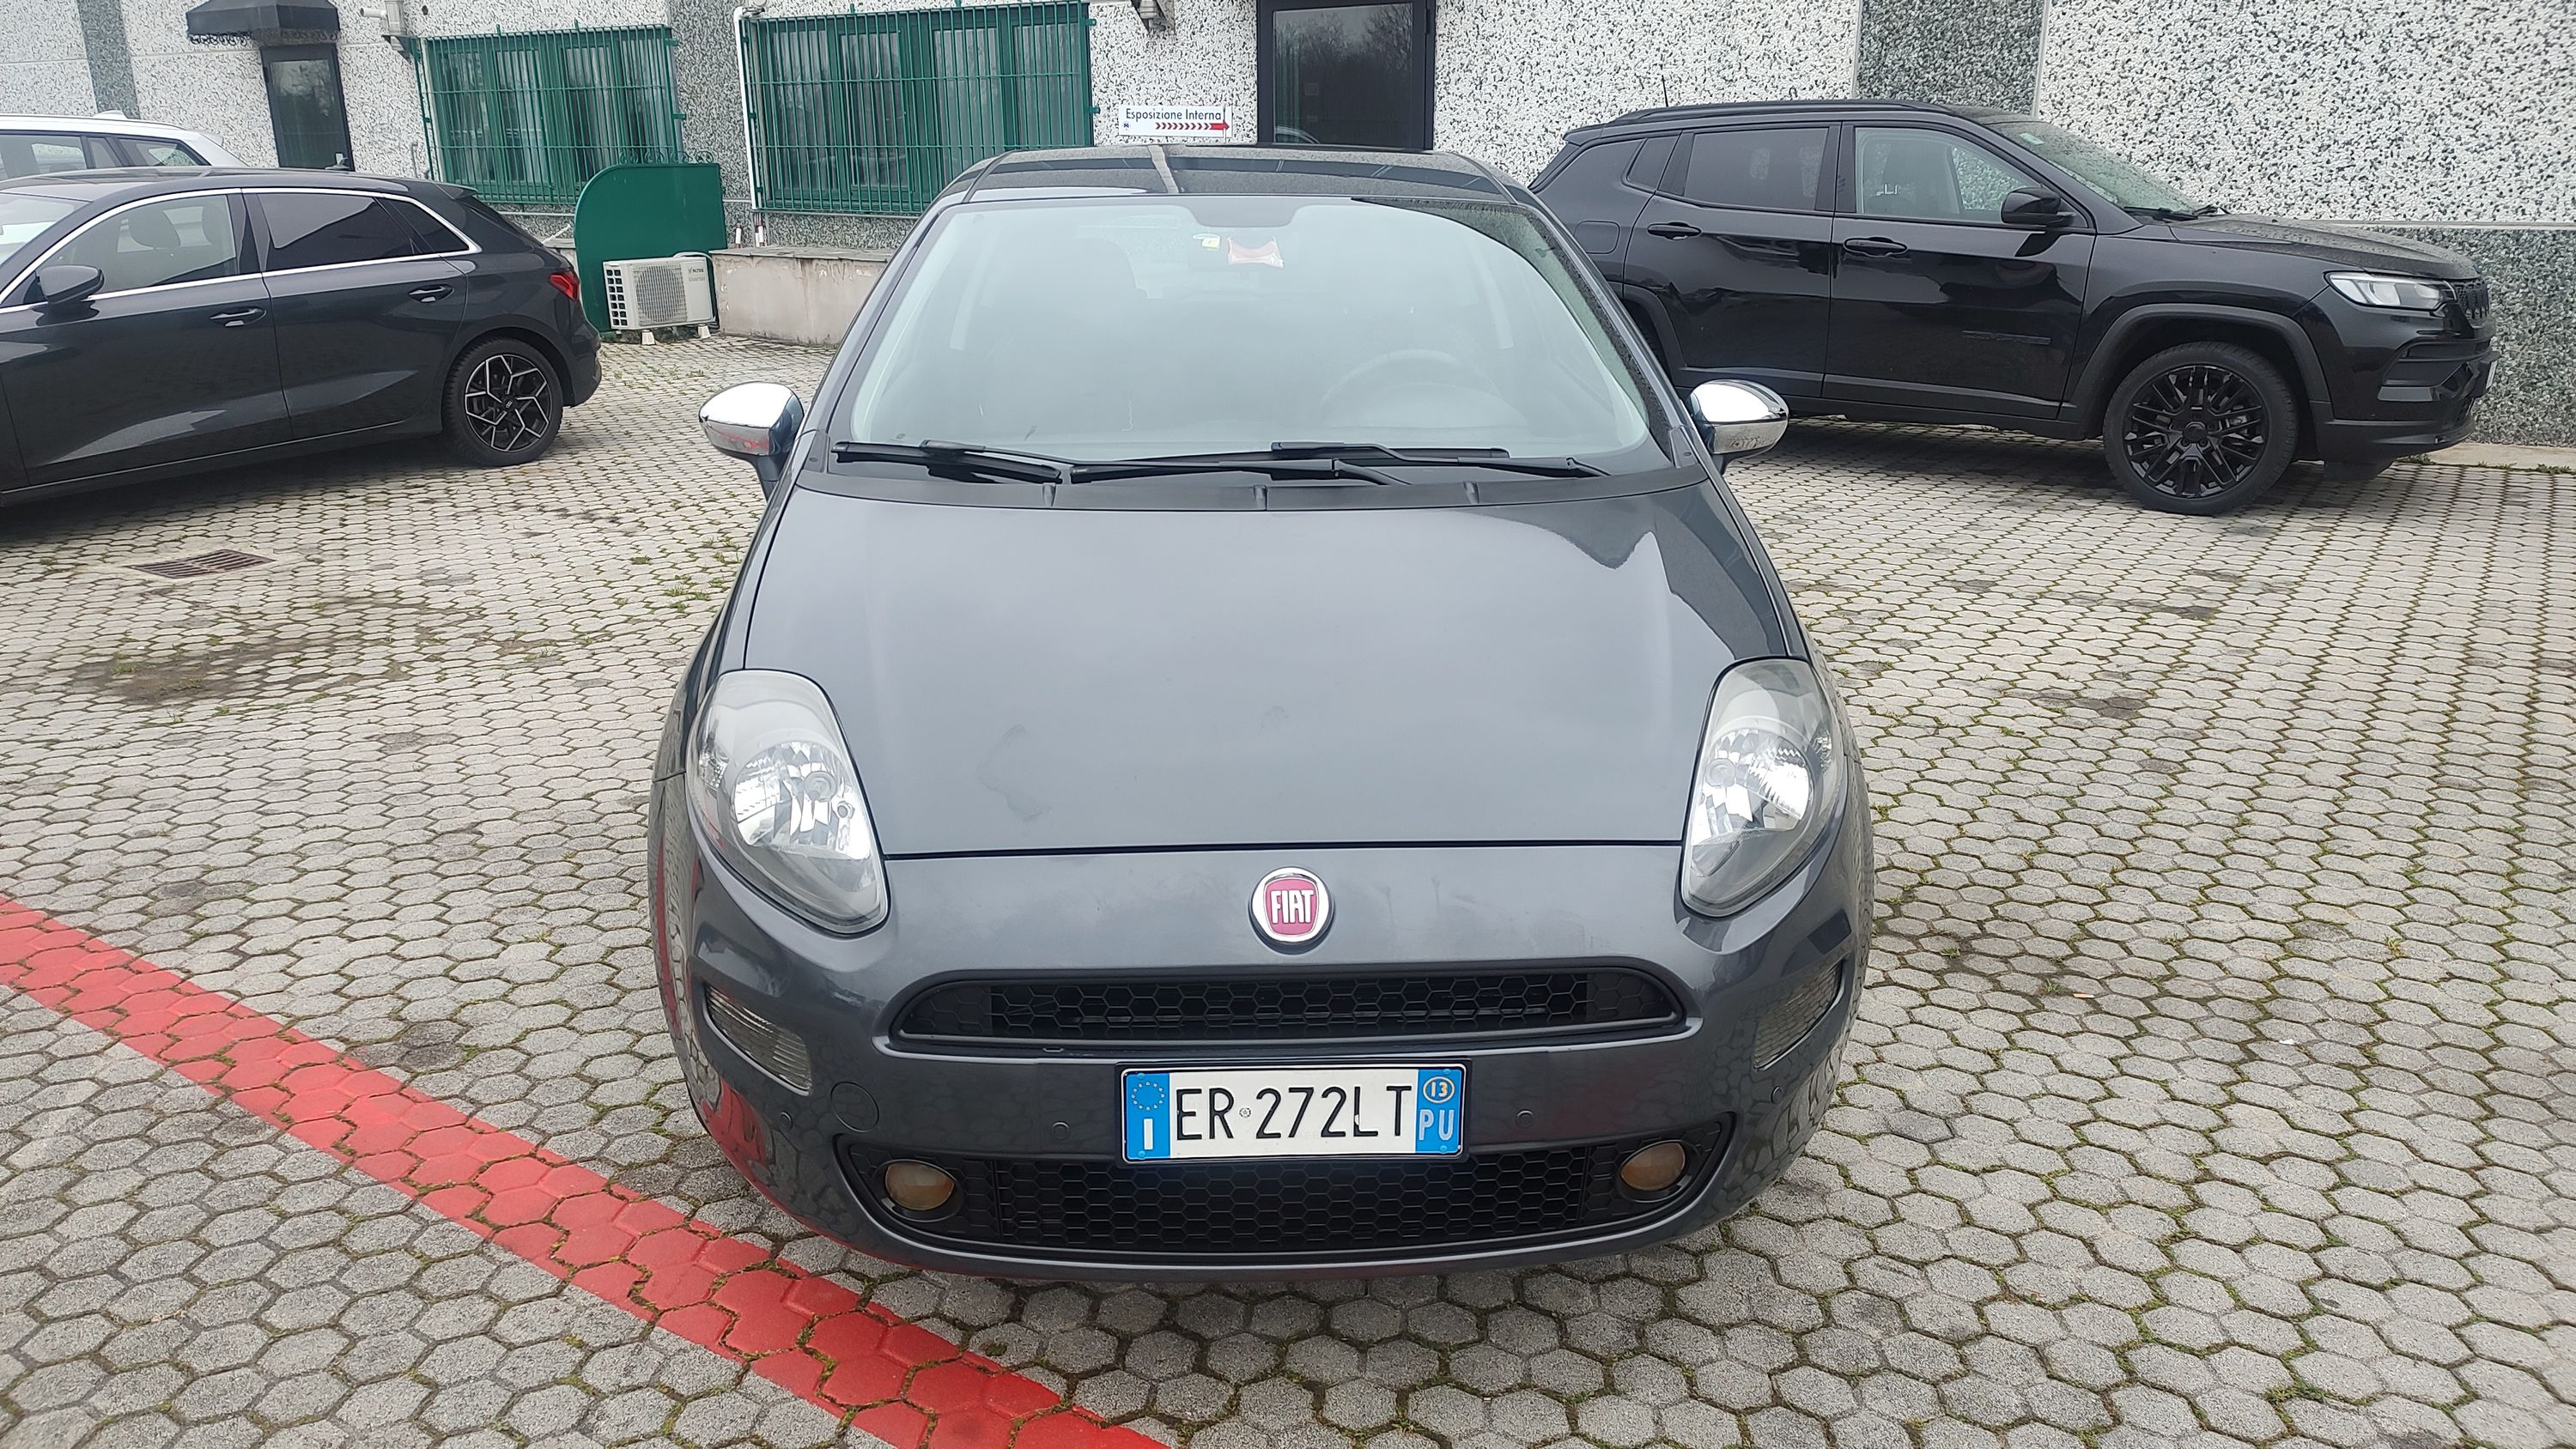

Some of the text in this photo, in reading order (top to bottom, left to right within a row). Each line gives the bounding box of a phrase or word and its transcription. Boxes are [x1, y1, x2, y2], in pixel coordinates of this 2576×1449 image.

[1125, 107, 1222, 122] Esposizione Interna
[1270, 889, 1315, 925] FIAT
[1430, 1081, 1449, 1098] 13
[1176, 1085, 1413, 1141] ER 272LT
[1418, 1108, 1455, 1142] PU
[1143, 1118, 1154, 1150] I
